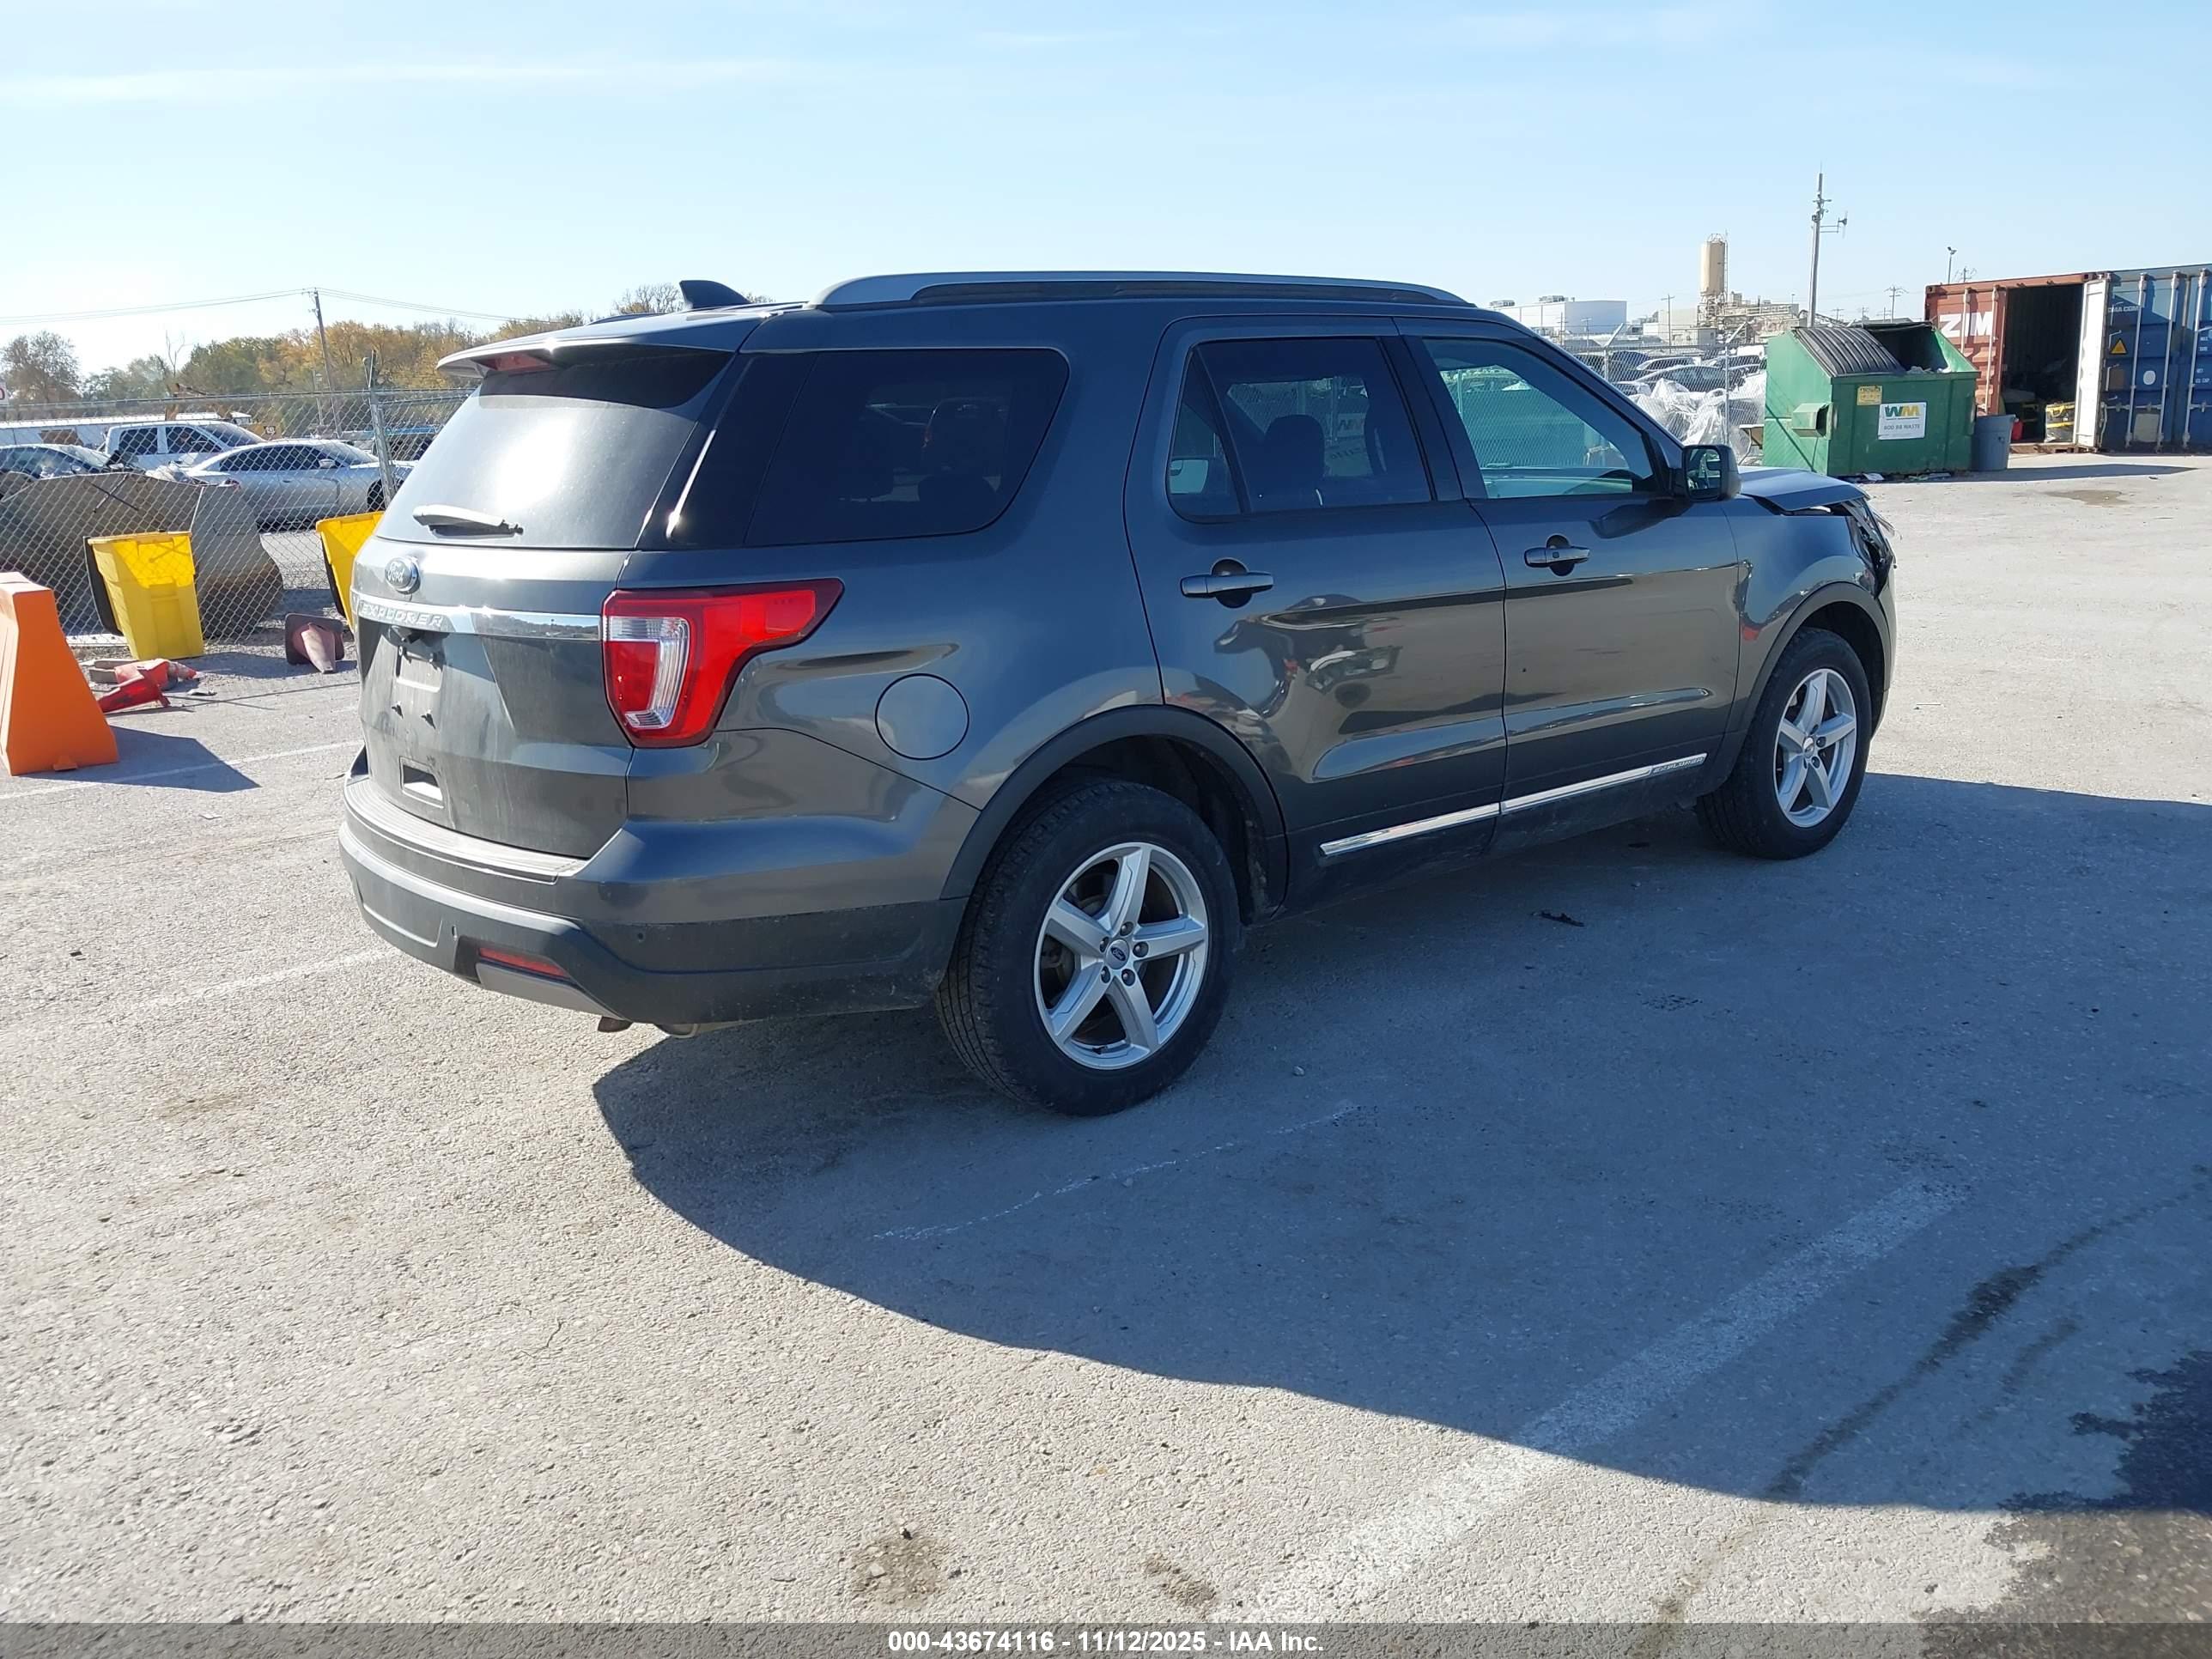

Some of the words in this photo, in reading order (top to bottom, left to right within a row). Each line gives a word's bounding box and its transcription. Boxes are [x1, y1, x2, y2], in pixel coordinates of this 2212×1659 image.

[1940, 312, 1993, 338] ZIM
[1885, 405, 1920, 417] WM
[387, 561, 405, 584] Ford
[362, 603, 444, 626] EXPLORER
